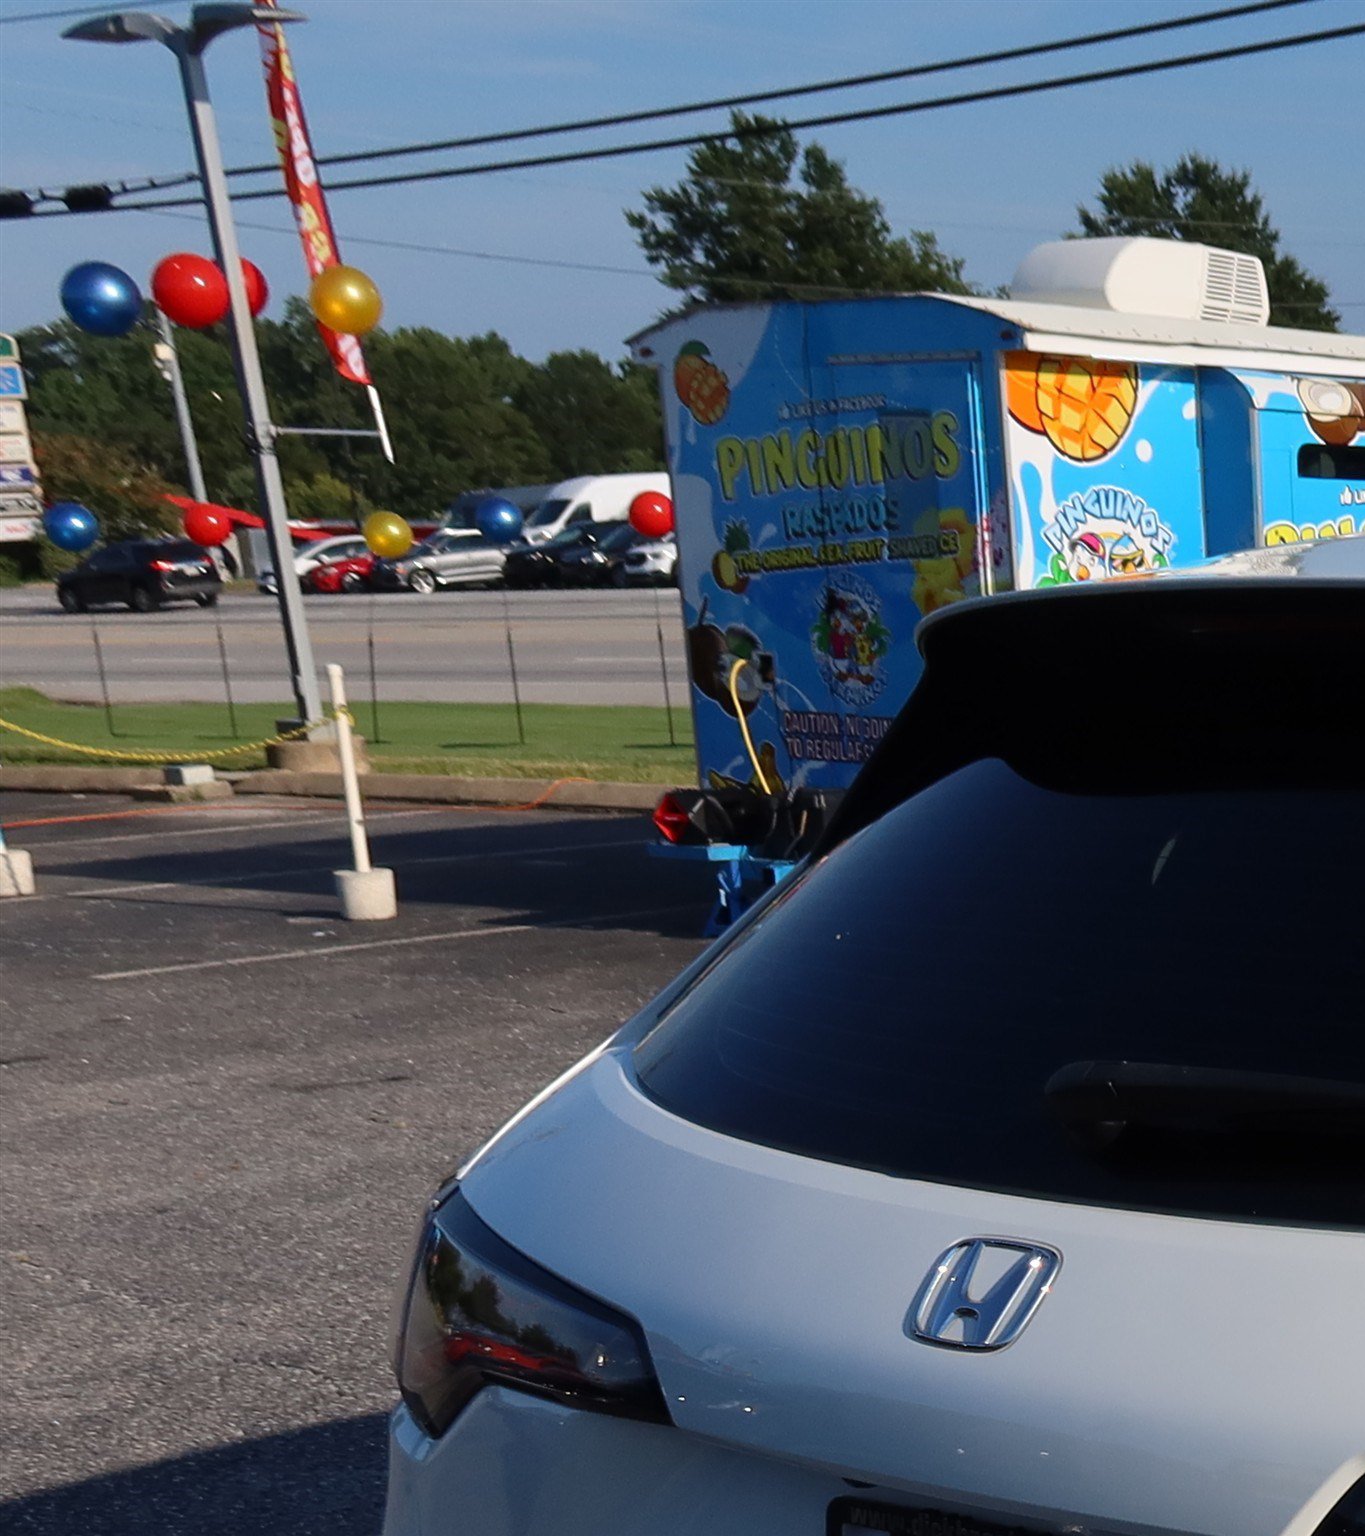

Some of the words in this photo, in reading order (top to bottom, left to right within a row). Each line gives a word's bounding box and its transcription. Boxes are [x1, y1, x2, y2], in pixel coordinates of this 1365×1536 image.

[716, 411, 960, 501] PINGUINOS
[782, 495, 900, 541] RASPADOS
[1043, 486, 1173, 553] PINGUINOS
[737, 551, 761, 573] THE
[848, 537, 883, 562] FRUIT
[938, 531, 960, 554] CE
[784, 712, 840, 736] CAUTION
[786, 737, 804, 758] TO
